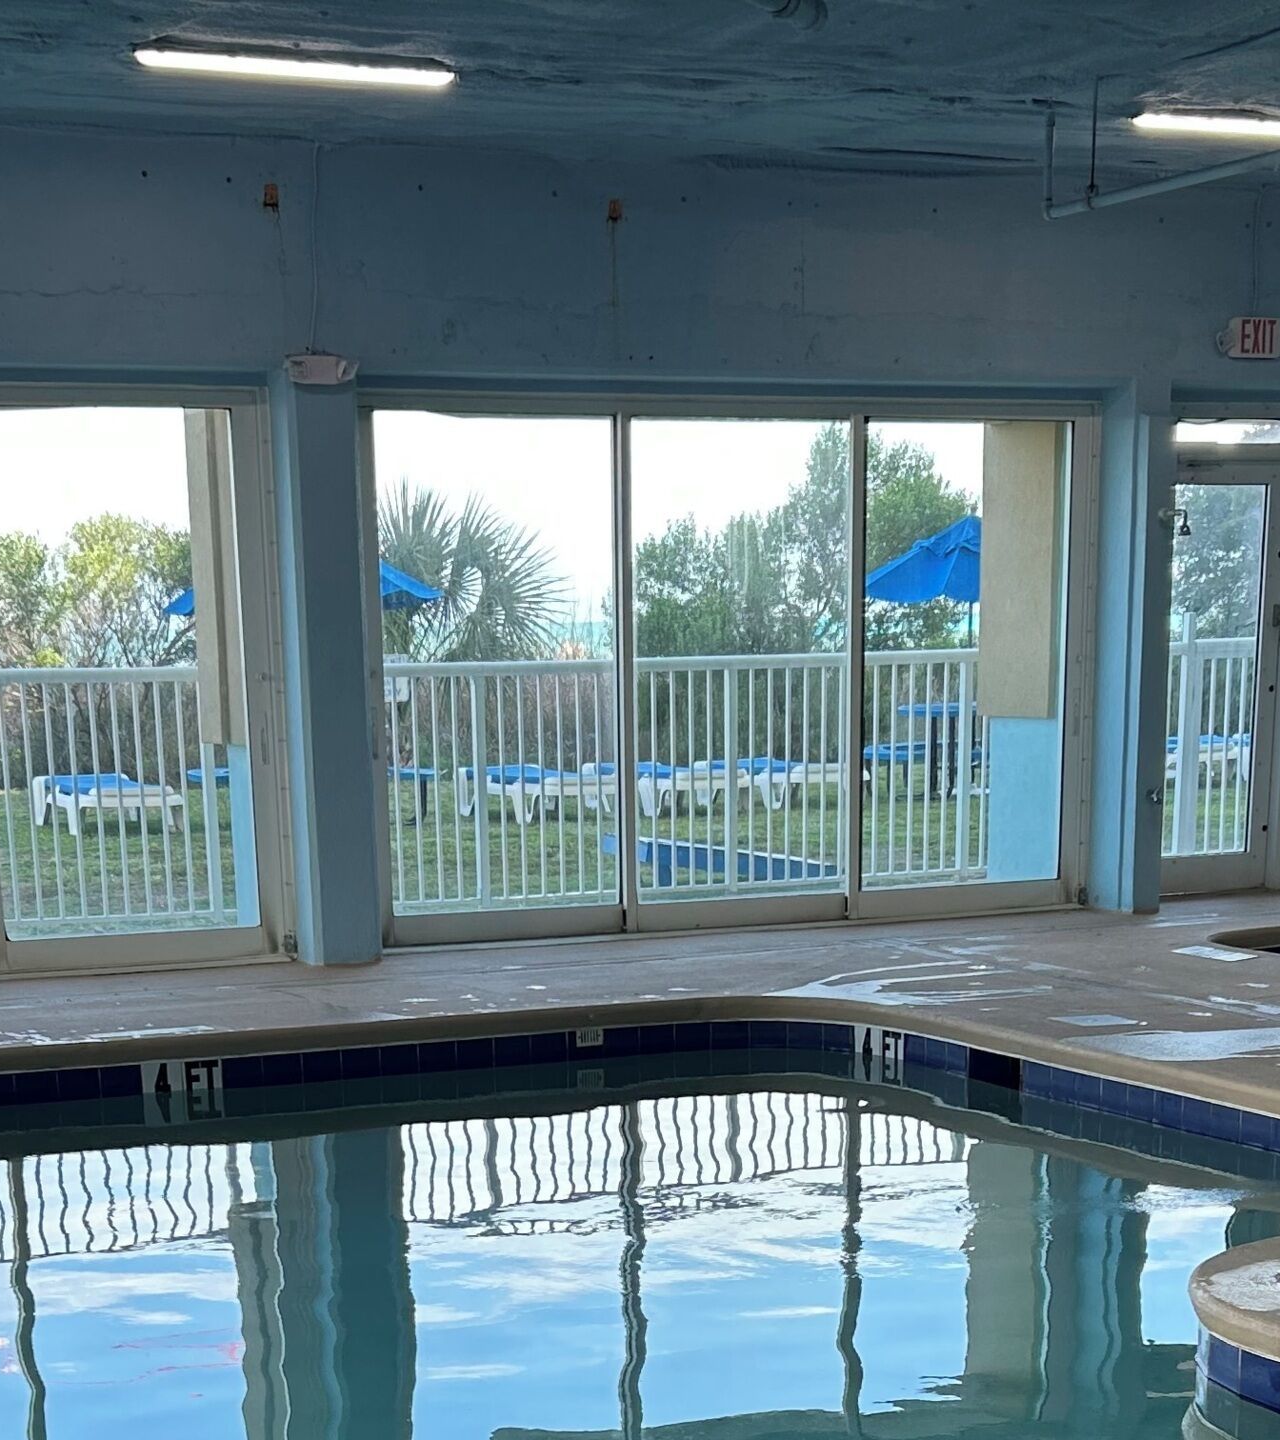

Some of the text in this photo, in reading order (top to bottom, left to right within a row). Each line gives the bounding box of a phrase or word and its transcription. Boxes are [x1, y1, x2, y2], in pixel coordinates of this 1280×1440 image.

[1240, 319, 1277, 354] EXIT
[862, 1027, 873, 1057] 4
[154, 1062, 172, 1093] 4
